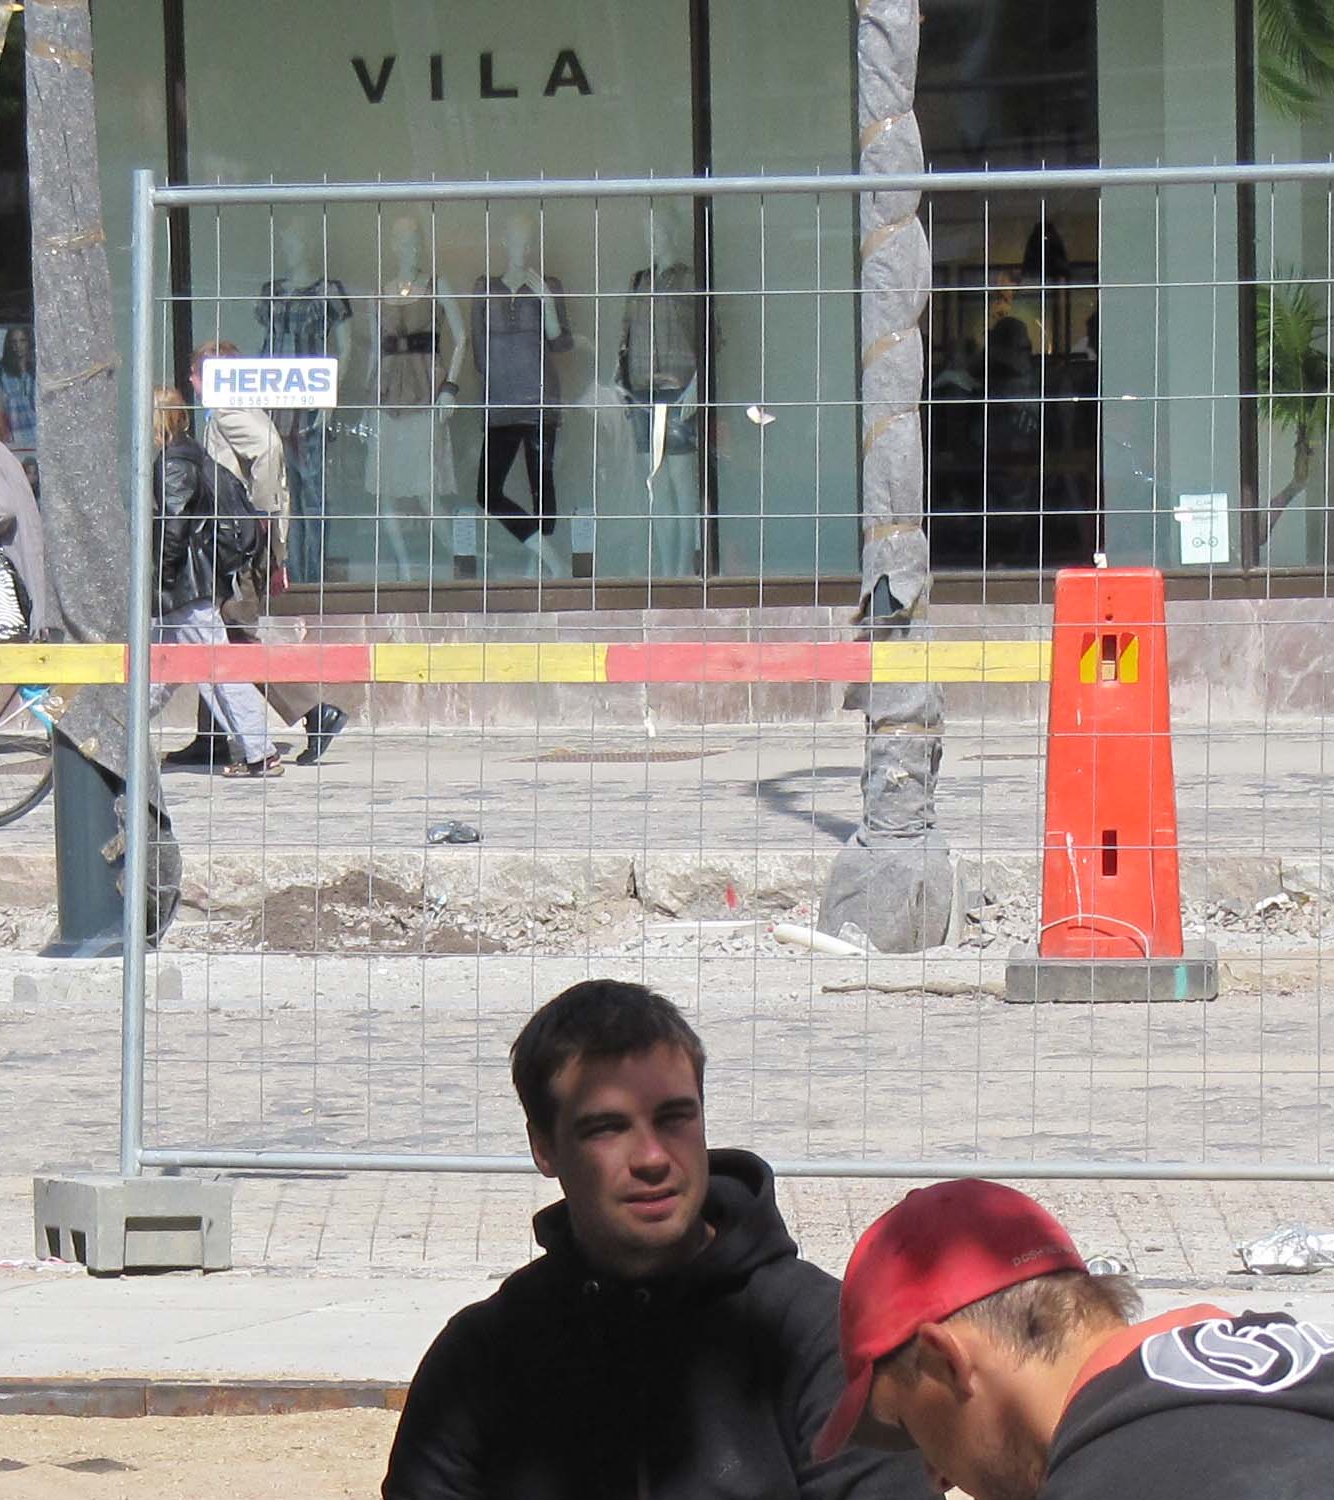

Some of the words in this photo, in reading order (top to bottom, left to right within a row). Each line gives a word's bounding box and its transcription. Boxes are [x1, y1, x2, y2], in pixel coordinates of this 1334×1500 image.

[350, 48, 593, 104] VILA
[214, 368, 331, 392] HERAS
[229, 396, 243, 406] 08
[275, 396, 296, 406] 777
[300, 396, 315, 406] 90
